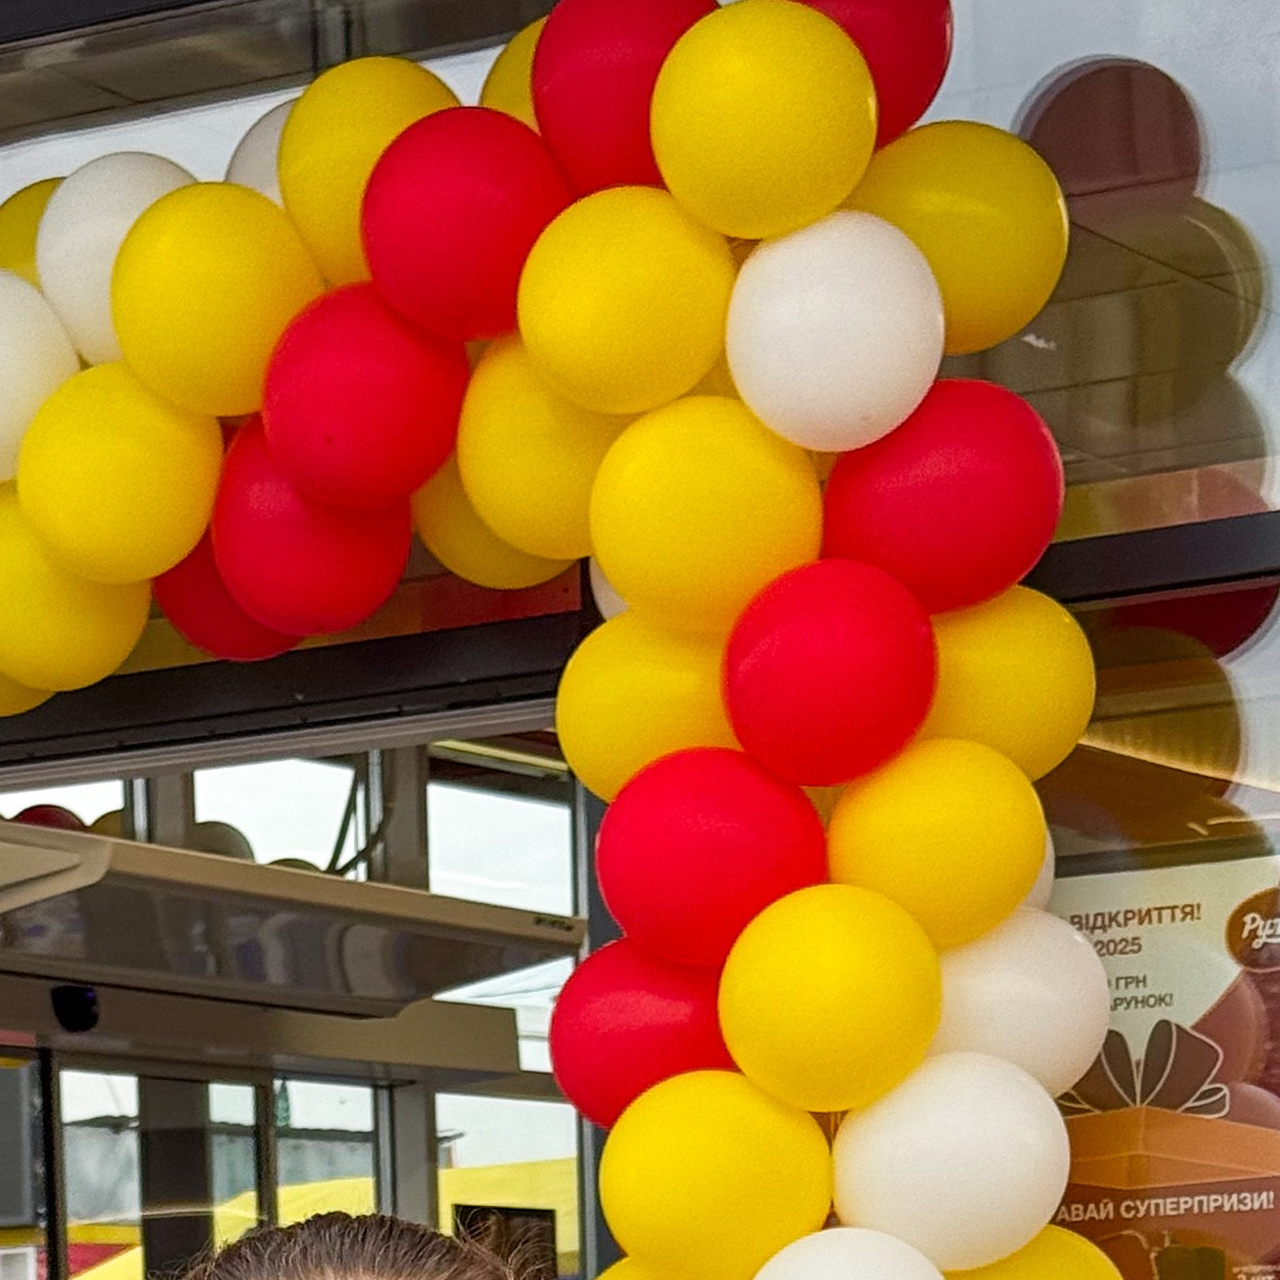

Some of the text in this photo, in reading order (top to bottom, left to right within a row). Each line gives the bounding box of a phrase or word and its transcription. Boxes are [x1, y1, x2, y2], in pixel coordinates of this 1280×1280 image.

[1094, 937, 1142, 957] 2025
[1115, 974, 1147, 990] ГРН
[1055, 1191, 1275, 1222] АВАЙ СУПЕРПРИЗИ!
